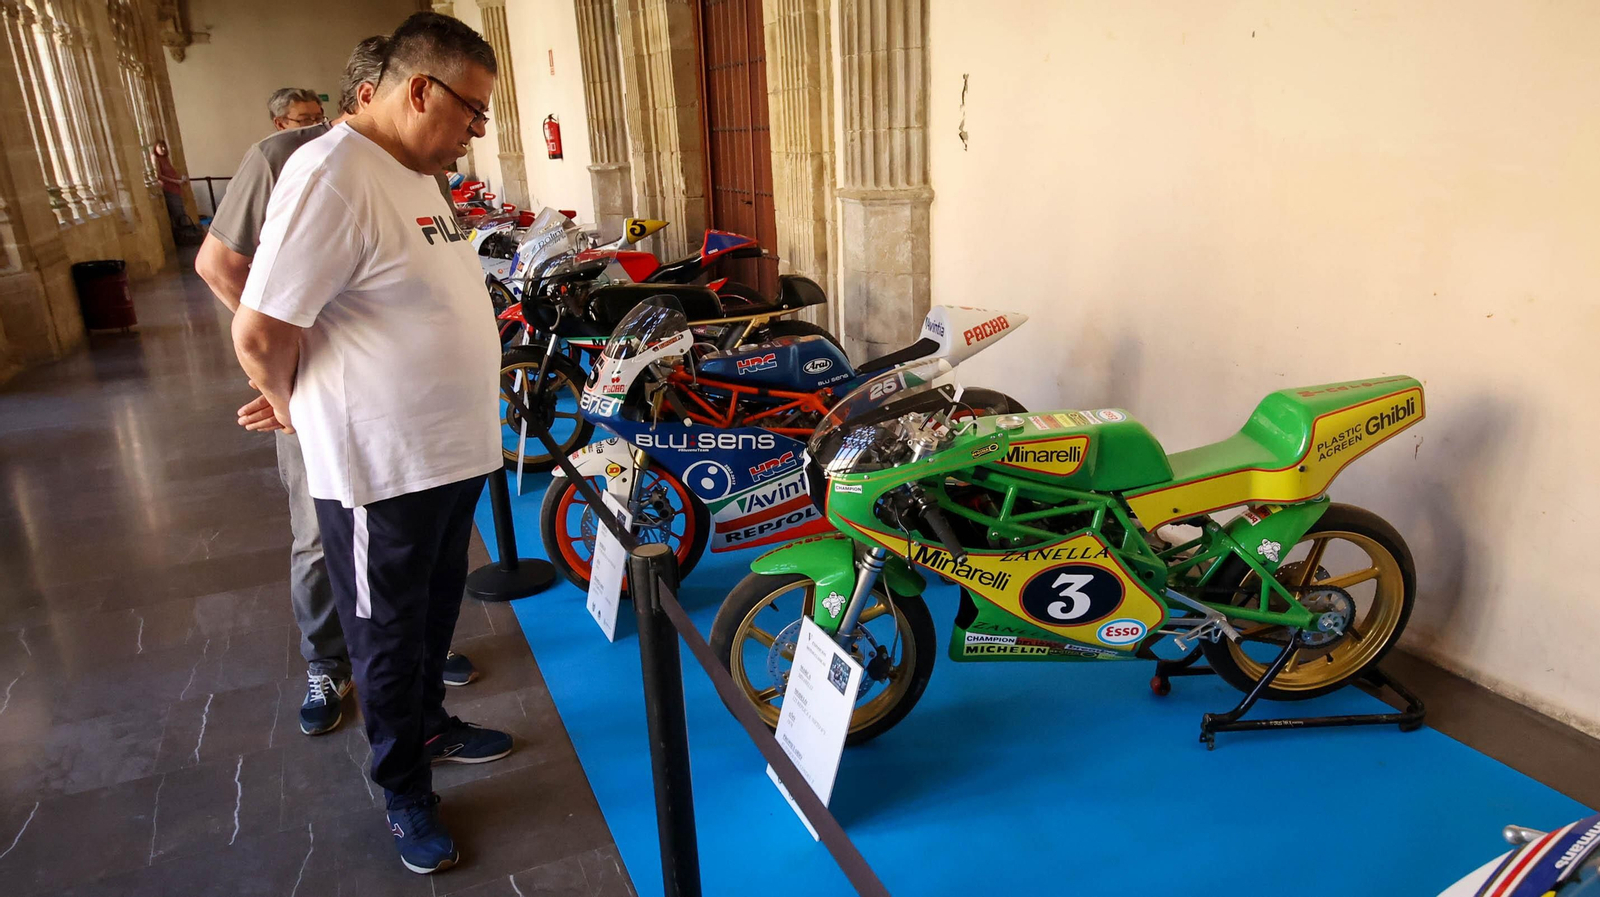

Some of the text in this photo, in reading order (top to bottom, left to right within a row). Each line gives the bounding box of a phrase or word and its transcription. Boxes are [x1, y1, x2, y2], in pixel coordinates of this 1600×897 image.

[629, 219, 647, 237] 5
[963, 315, 1010, 346] PACHA
[737, 353, 777, 375] HRC
[869, 377, 897, 401] 25
[1365, 397, 1415, 436] Ghibli
[1317, 423, 1362, 453] PLASTIC
[1318, 433, 1363, 462] ACREEN
[749, 451, 797, 482] HRC
[1001, 446, 1081, 463] Minarelli
[725, 507, 816, 543] REPSOL
[913, 546, 1012, 591] Minarelli
[1000, 546, 1111, 562] ZANELLA
[1047, 572, 1094, 620] 3
[965, 645, 1048, 655] MICHELIN
[966, 635, 1016, 644] CHAMPION
